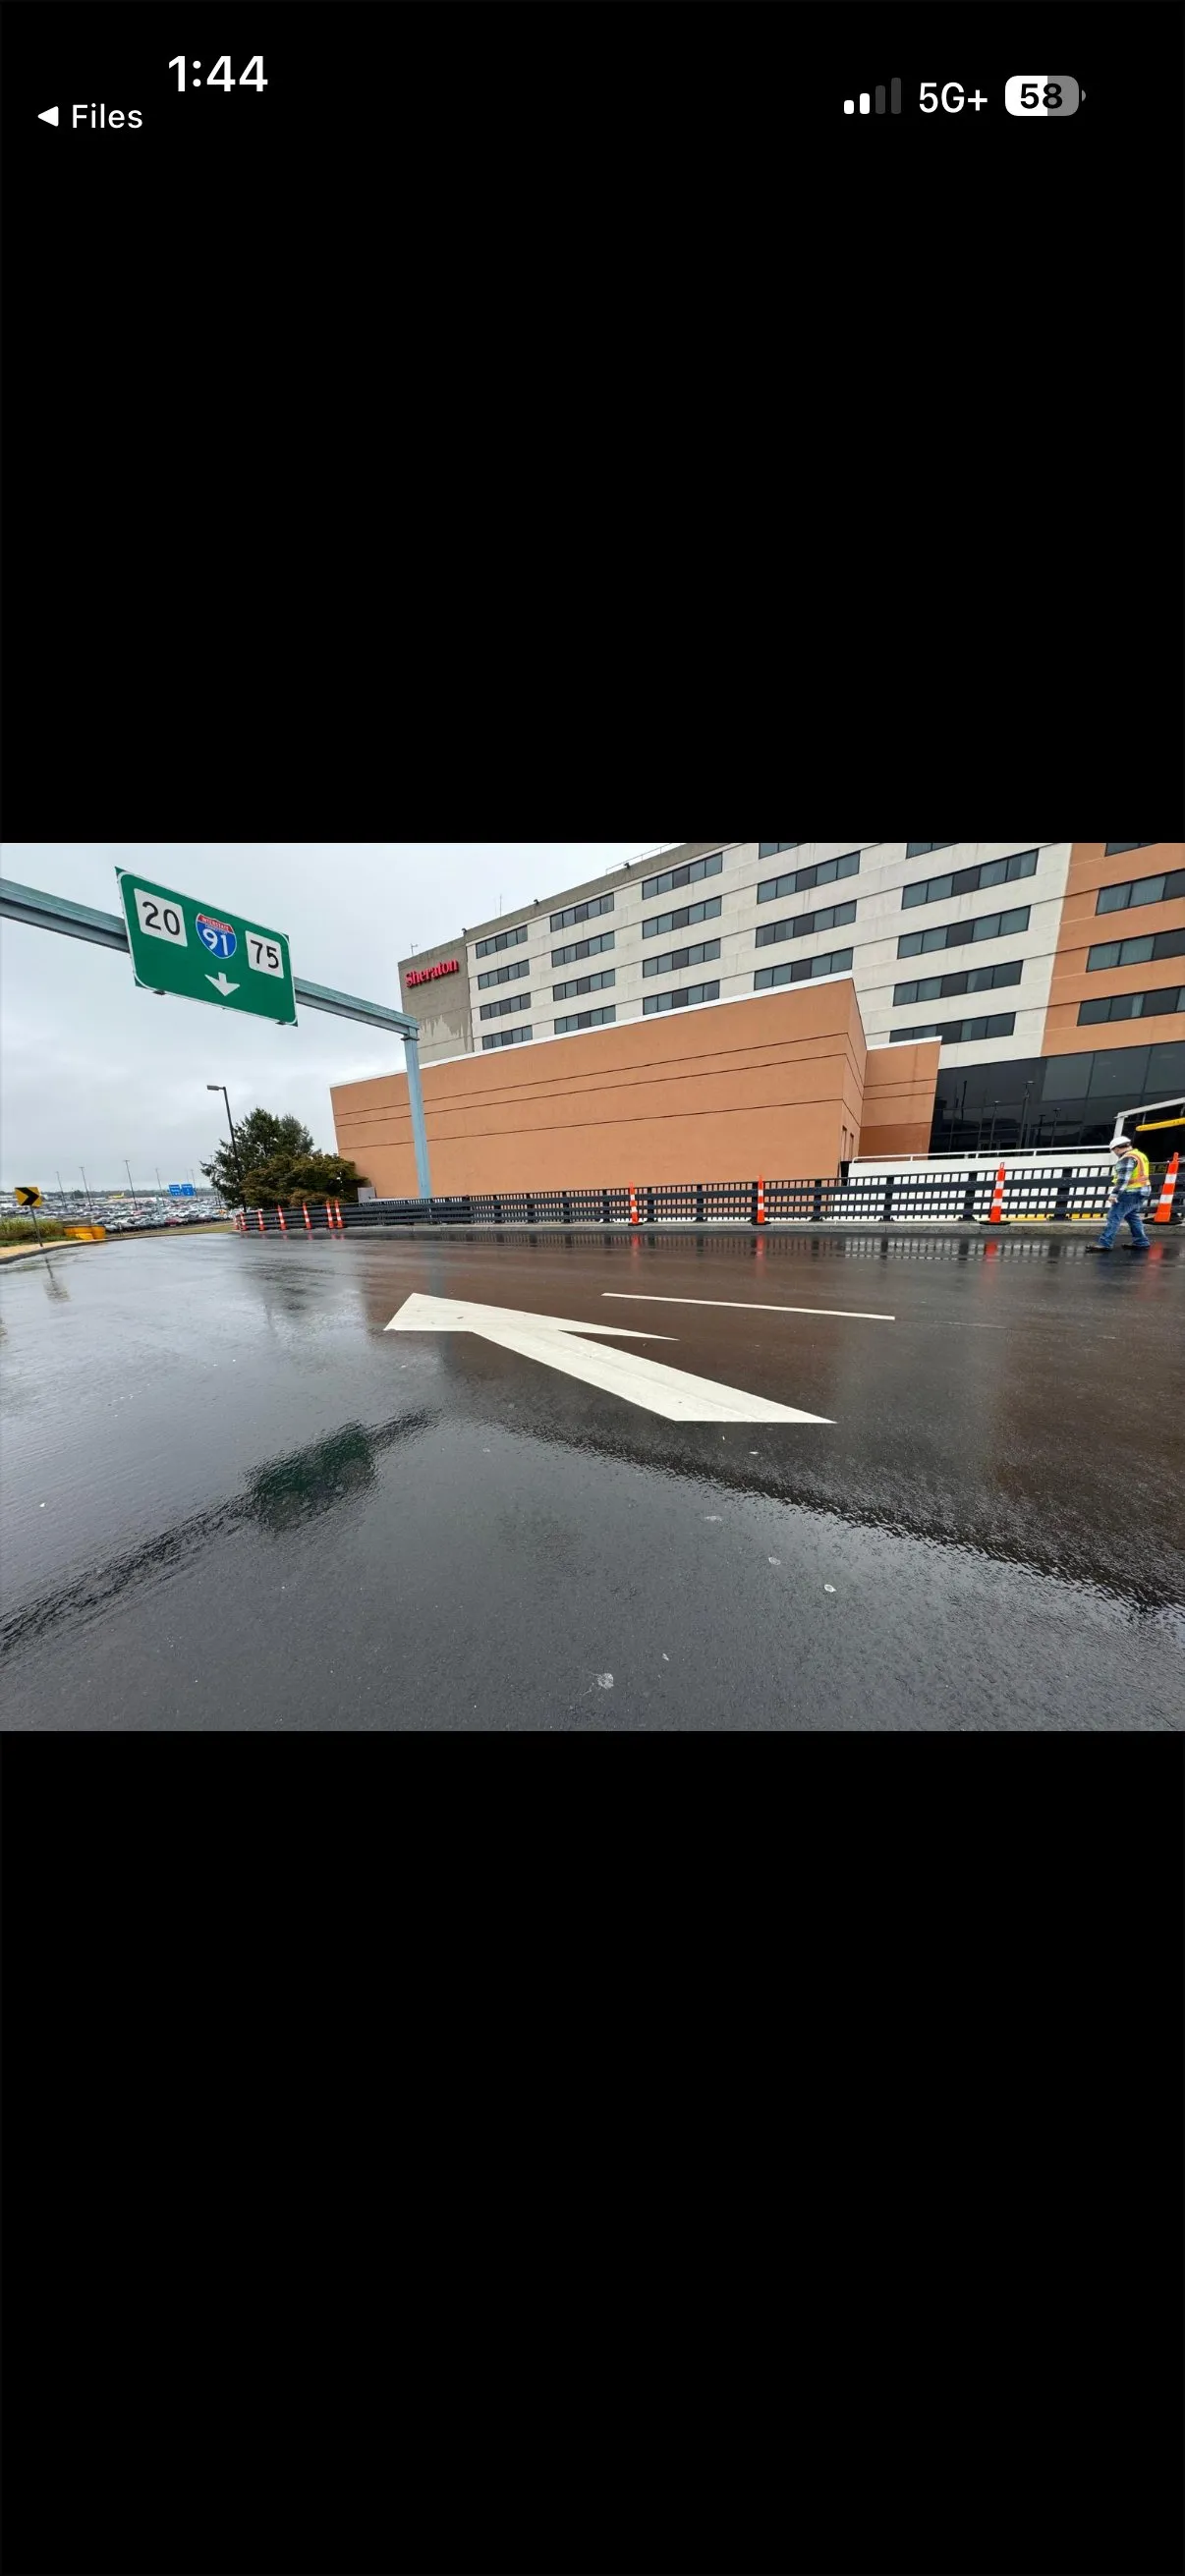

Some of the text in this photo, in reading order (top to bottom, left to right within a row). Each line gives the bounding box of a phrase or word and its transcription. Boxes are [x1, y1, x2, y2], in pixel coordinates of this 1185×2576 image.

[142, 901, 181, 936] 20
[202, 928, 229, 956] 91
[250, 939, 280, 970] 75
[405, 959, 460, 987] Sheraton
